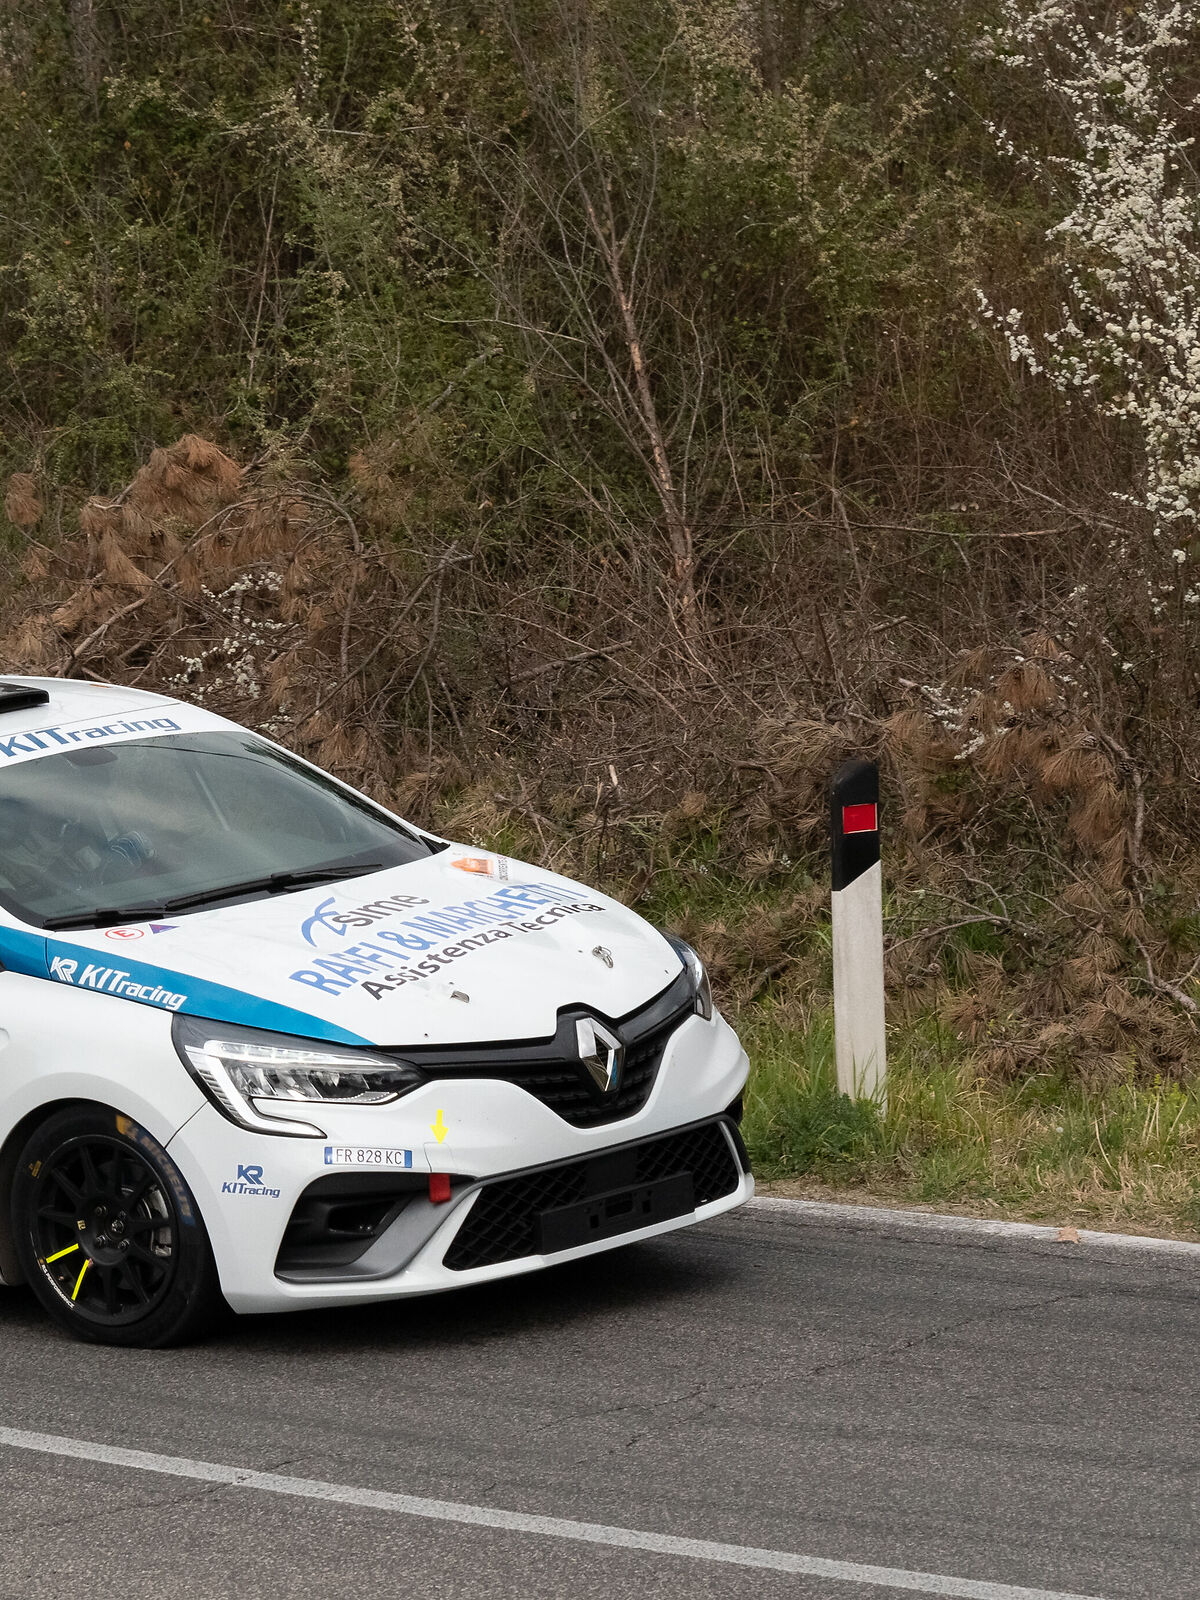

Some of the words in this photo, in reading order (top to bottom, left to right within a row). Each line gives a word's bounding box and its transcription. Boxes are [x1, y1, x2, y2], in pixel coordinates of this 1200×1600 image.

[399, 882, 589, 939] MARCHETTI
[361, 929, 513, 1001] Assistenza
[498, 902, 606, 933] Tecnica
[377, 930, 439, 951] &
[78, 964, 188, 1011] KITracing
[288, 941, 411, 997] RAFFI
[335, 1148, 353, 1163] FR
[357, 1149, 382, 1164] 828
[385, 1151, 403, 1165] KC
[221, 1181, 281, 1199] KITracing
